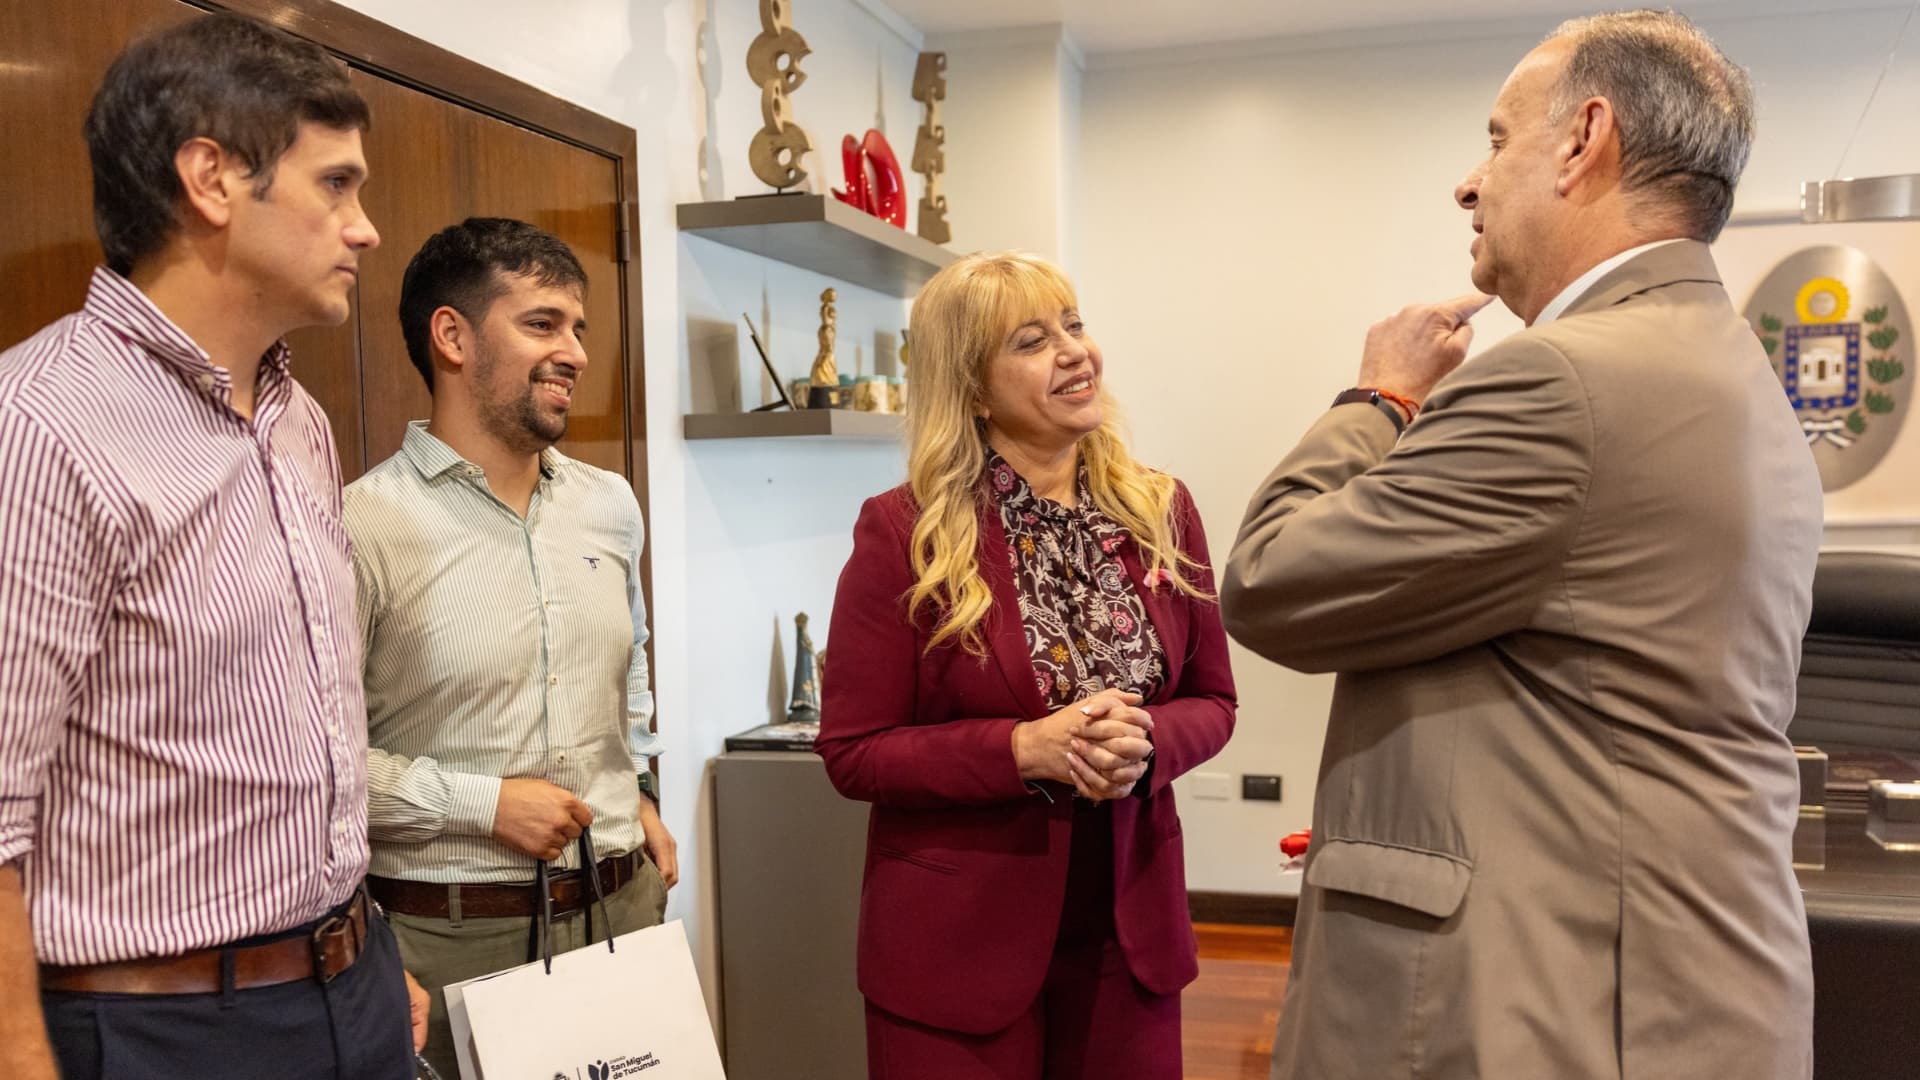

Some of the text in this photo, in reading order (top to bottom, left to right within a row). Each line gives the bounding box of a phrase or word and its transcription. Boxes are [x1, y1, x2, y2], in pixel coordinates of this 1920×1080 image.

[611, 1062, 626, 1072] San
[626, 1051, 652, 1067] Miguel
[613, 1071, 623, 1080] de
[623, 1058, 660, 1076] Tucumán
